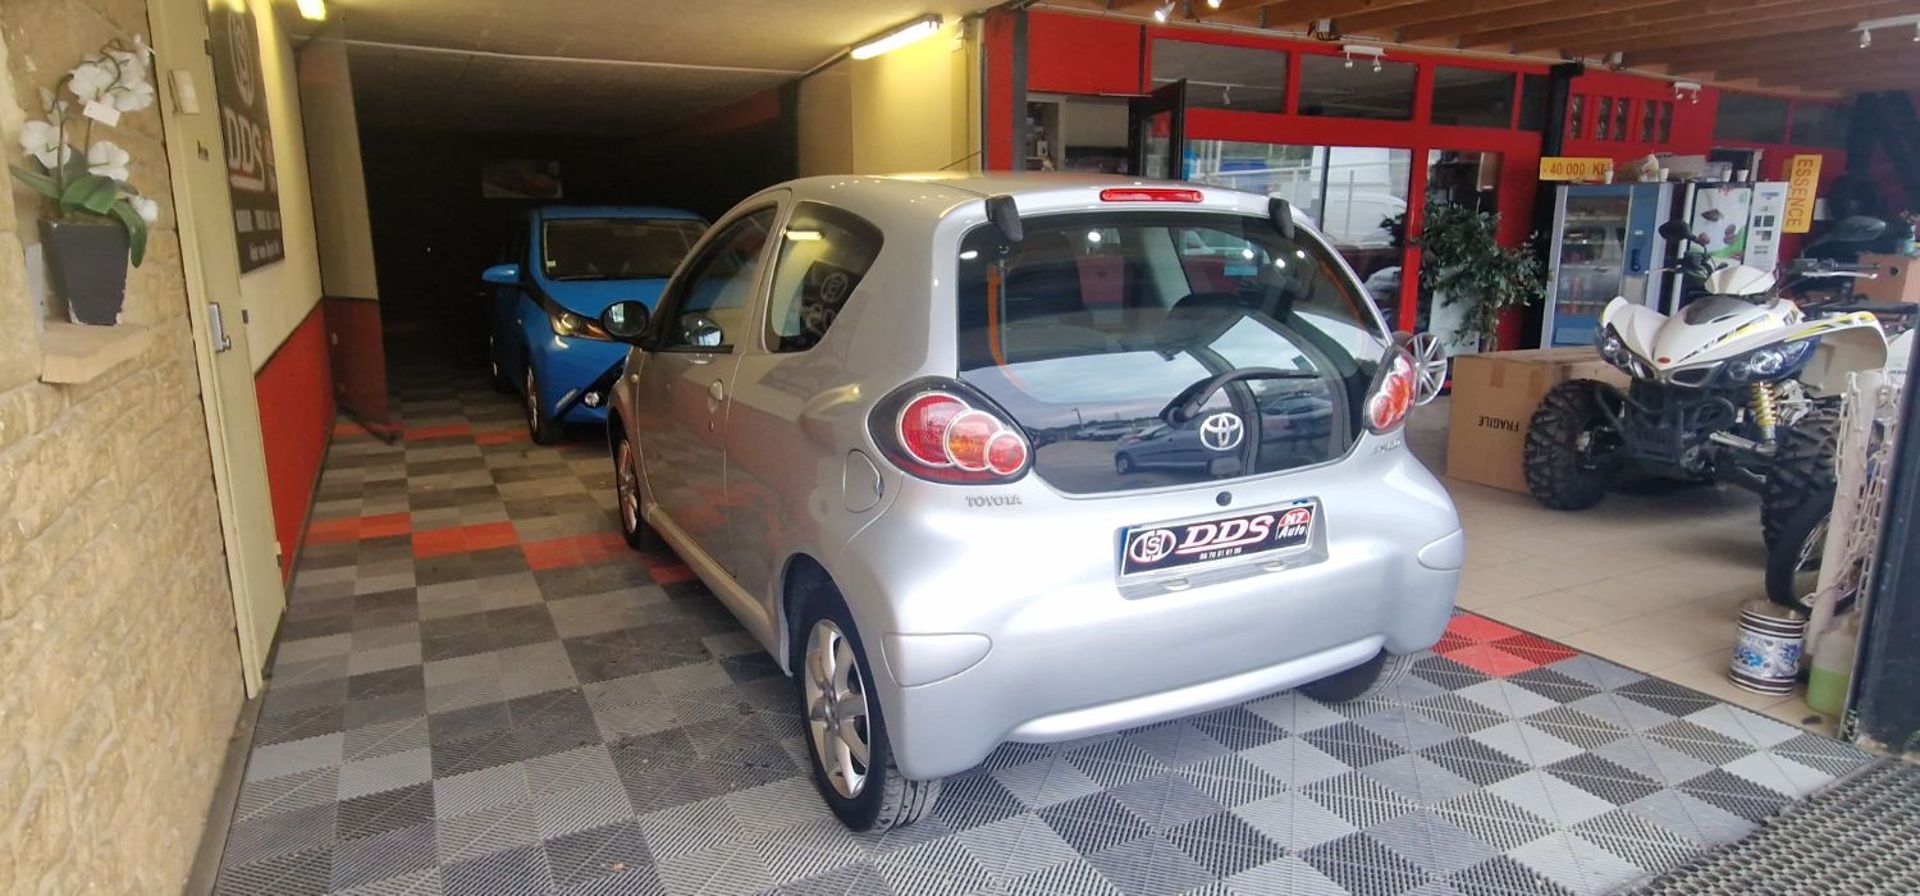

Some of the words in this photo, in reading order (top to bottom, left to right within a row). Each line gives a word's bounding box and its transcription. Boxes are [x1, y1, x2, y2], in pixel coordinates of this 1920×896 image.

[224, 106, 266, 190] DDS
[1550, 163, 1562, 175] 40
[1566, 162, 1586, 175] 000
[1785, 159, 1814, 226] ESSENCE
[1478, 415, 1519, 432] FRAGILE
[965, 494, 1022, 507] TOYOTA
[1177, 515, 1275, 551] DDS
[1279, 525, 1306, 539] Auto
